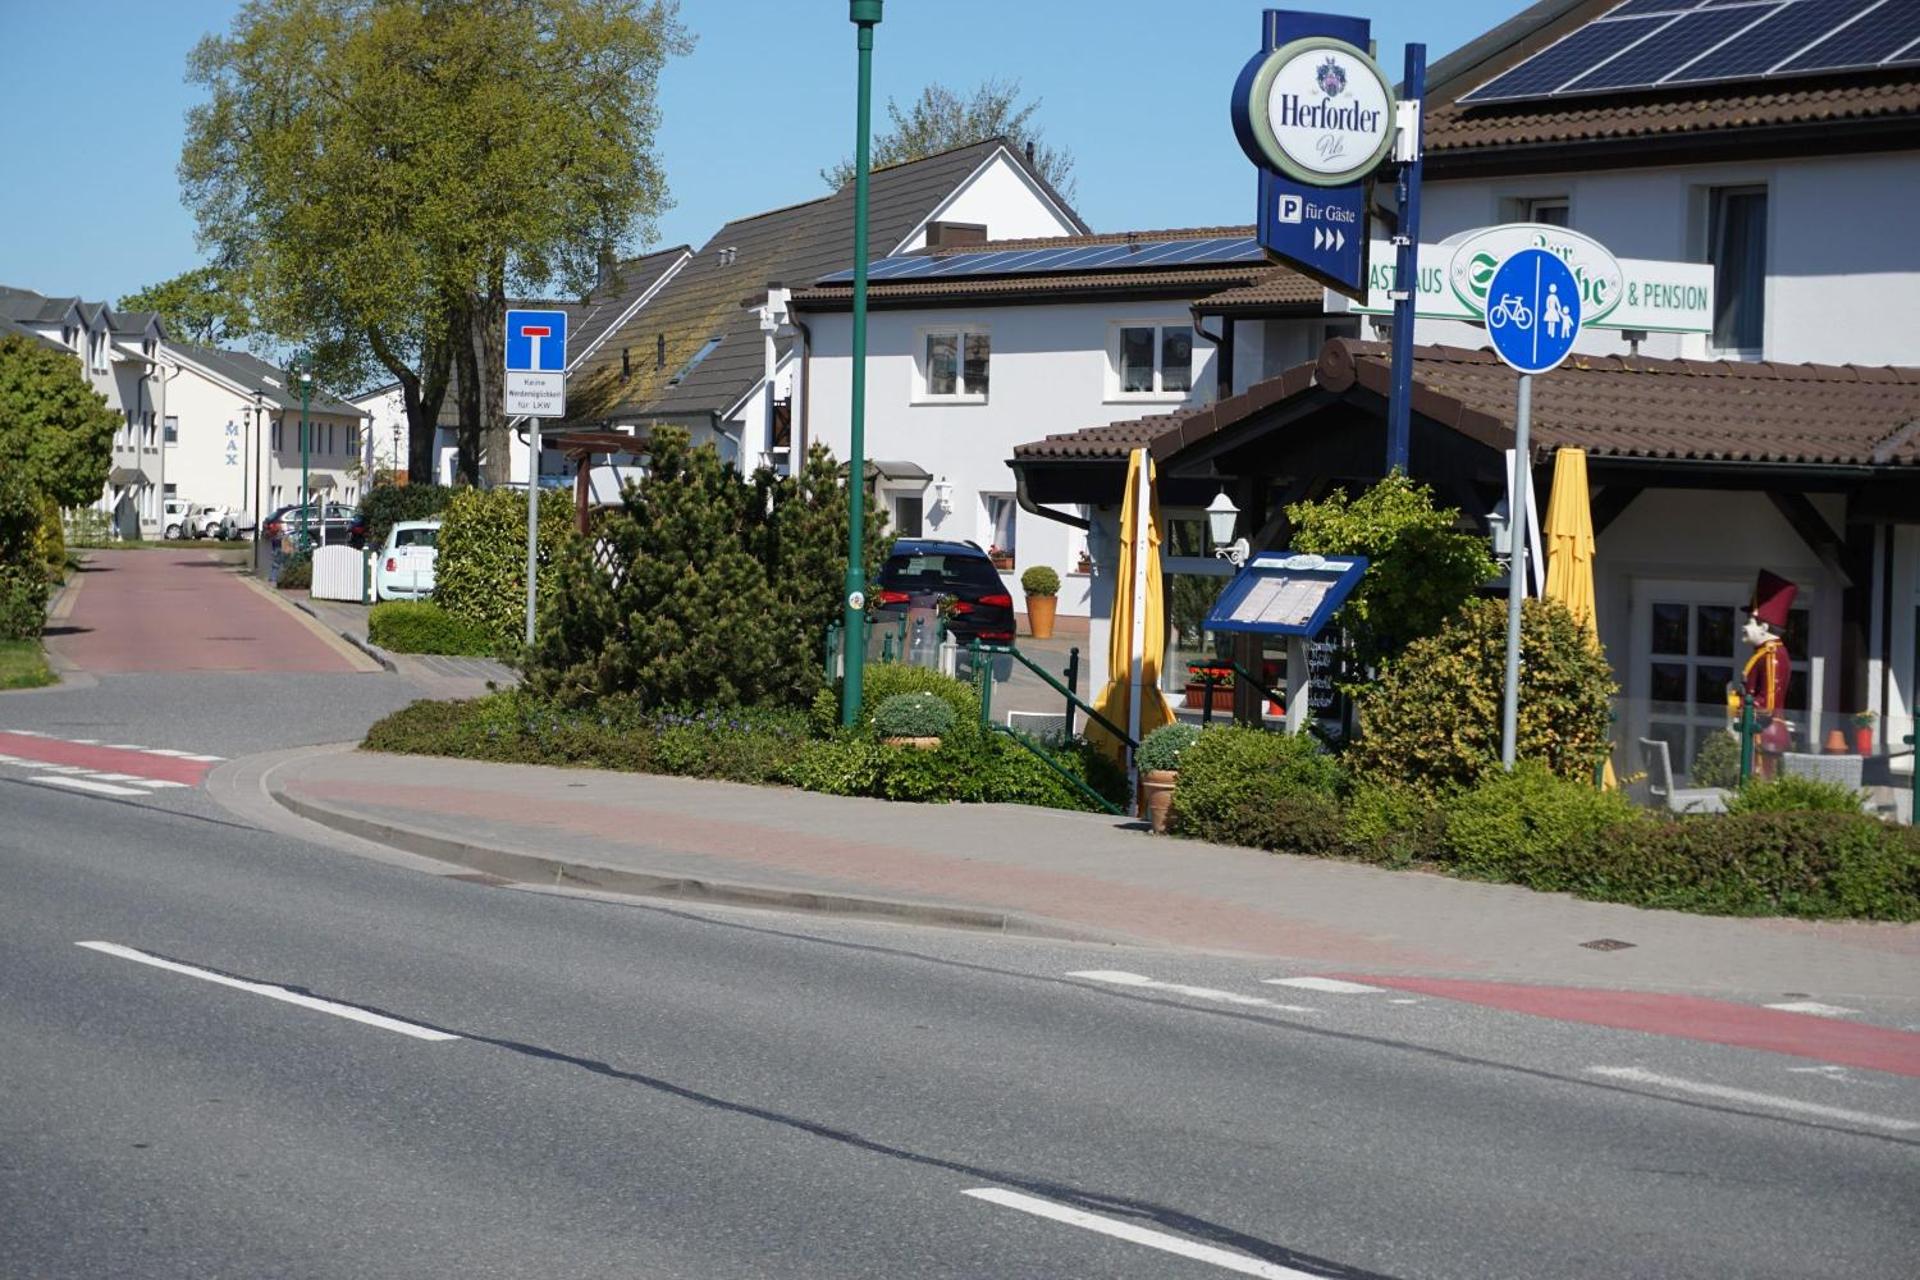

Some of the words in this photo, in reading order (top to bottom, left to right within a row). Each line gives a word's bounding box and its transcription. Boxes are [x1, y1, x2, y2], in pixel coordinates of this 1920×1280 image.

[1281, 94, 1380, 133] Herforder
[1316, 134, 1345, 157] Pils
[1284, 200, 1297, 218] P
[1305, 203, 1324, 219] für
[1326, 205, 1355, 223] Gäste
[1628, 282, 1639, 306] &
[1644, 283, 1707, 310] PENSION
[518, 401, 529, 409] für
[533, 401, 551, 409] LKW
